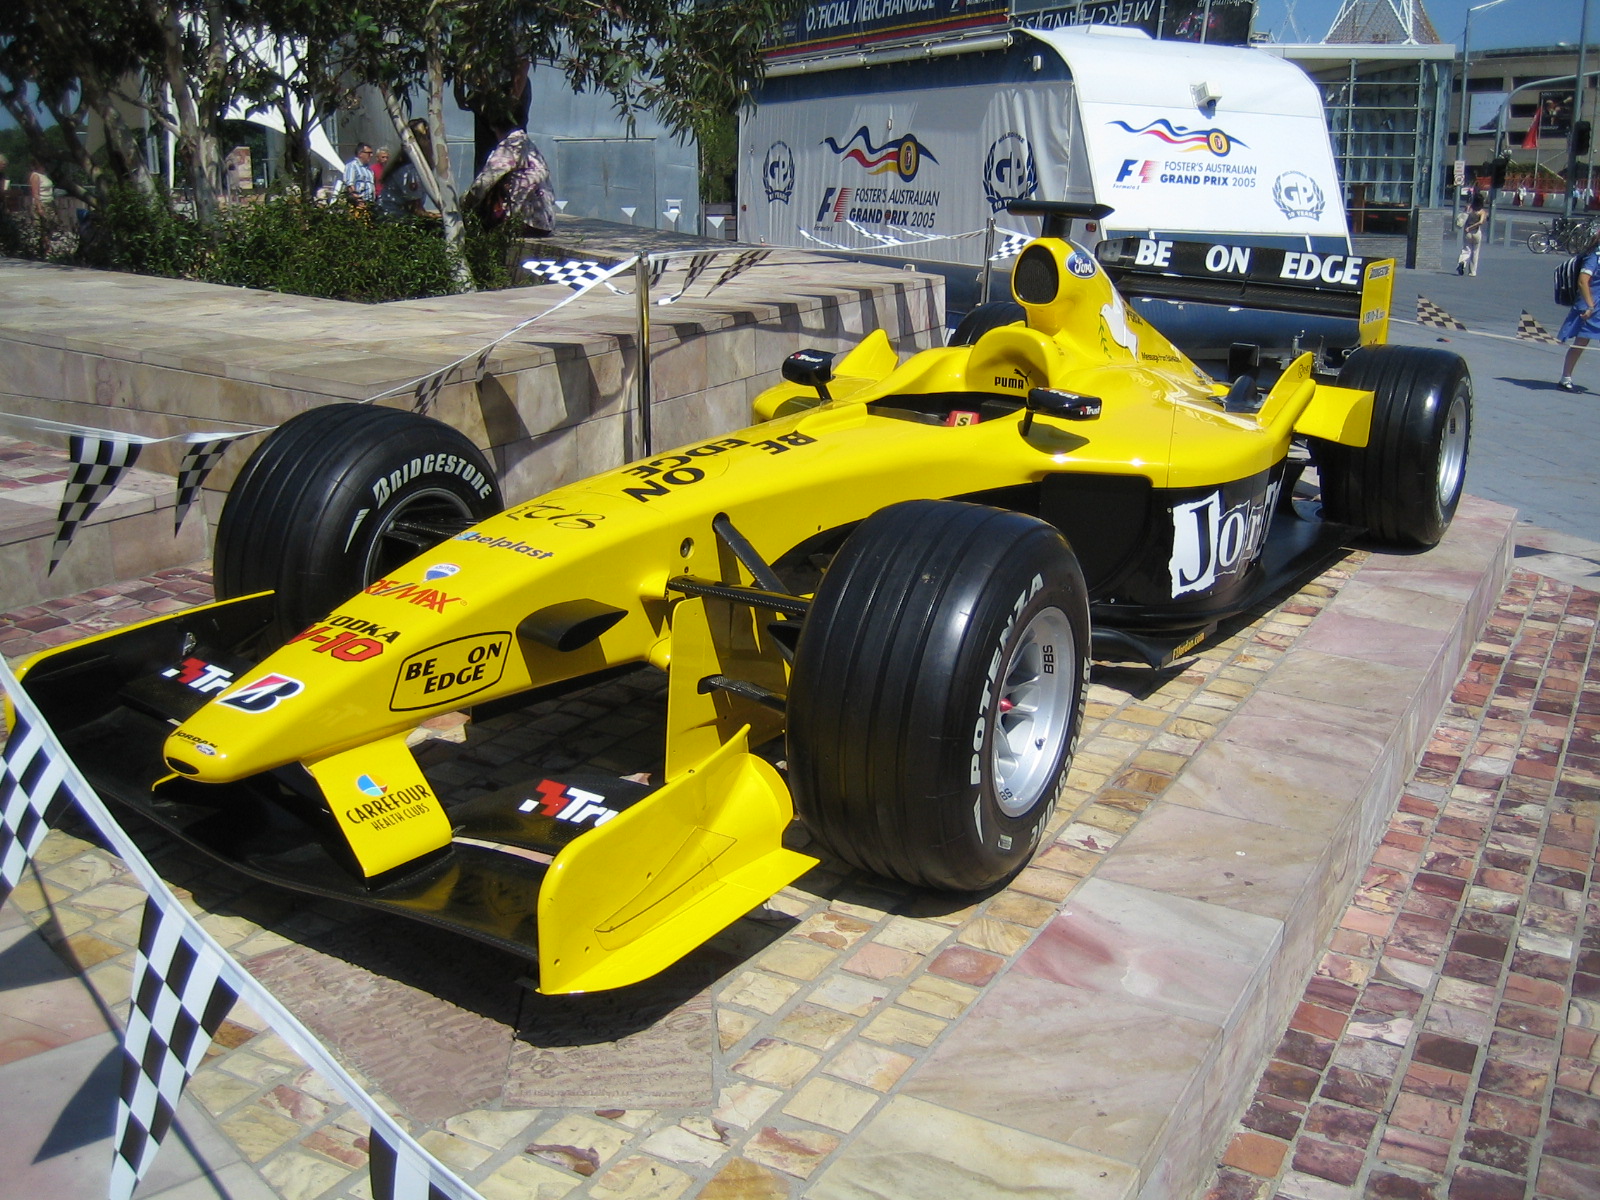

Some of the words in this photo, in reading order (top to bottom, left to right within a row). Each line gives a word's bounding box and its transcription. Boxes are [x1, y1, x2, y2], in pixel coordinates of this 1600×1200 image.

[805, 1, 850, 32] OFICIAL
[1159, 174, 1201, 185] GRAND
[1203, 175, 1229, 187] PRIX
[1232, 177, 1256, 188] 2005
[1164, 160, 1204, 173] FOSTER'S
[1205, 162, 1258, 176] AUSTRALIAN
[855, 188, 888, 204] FOSTER'S
[888, 188, 940, 207] AUSTRALIAN
[849, 207, 883, 224] GRAND
[910, 211, 936, 229] 2005
[1074, 254, 1094, 274] Ford
[1134, 239, 1174, 268] BE
[1205, 244, 1251, 274] ON
[1279, 251, 1363, 286] EDGE
[994, 376, 1024, 389] PUMA
[957, 416, 969, 427] S
[750, 429, 818, 455] BE
[621, 438, 751, 479] EDGE
[372, 453, 493, 509] BRIDGESTONE
[621, 467, 706, 503] ON
[466, 531, 555, 560] belplast
[285, 624, 384, 662] V-10
[322, 614, 402, 644] VODKA
[404, 657, 438, 682] BE
[467, 641, 503, 665] ON
[1043, 644, 1055, 675] BBS
[423, 663, 486, 695] EDGE
[970, 573, 1044, 786] POTENZA
[346, 784, 431, 824] CARREFOUR
[371, 811, 406, 832] HEALTH
[402, 802, 431, 819] CLUBS
